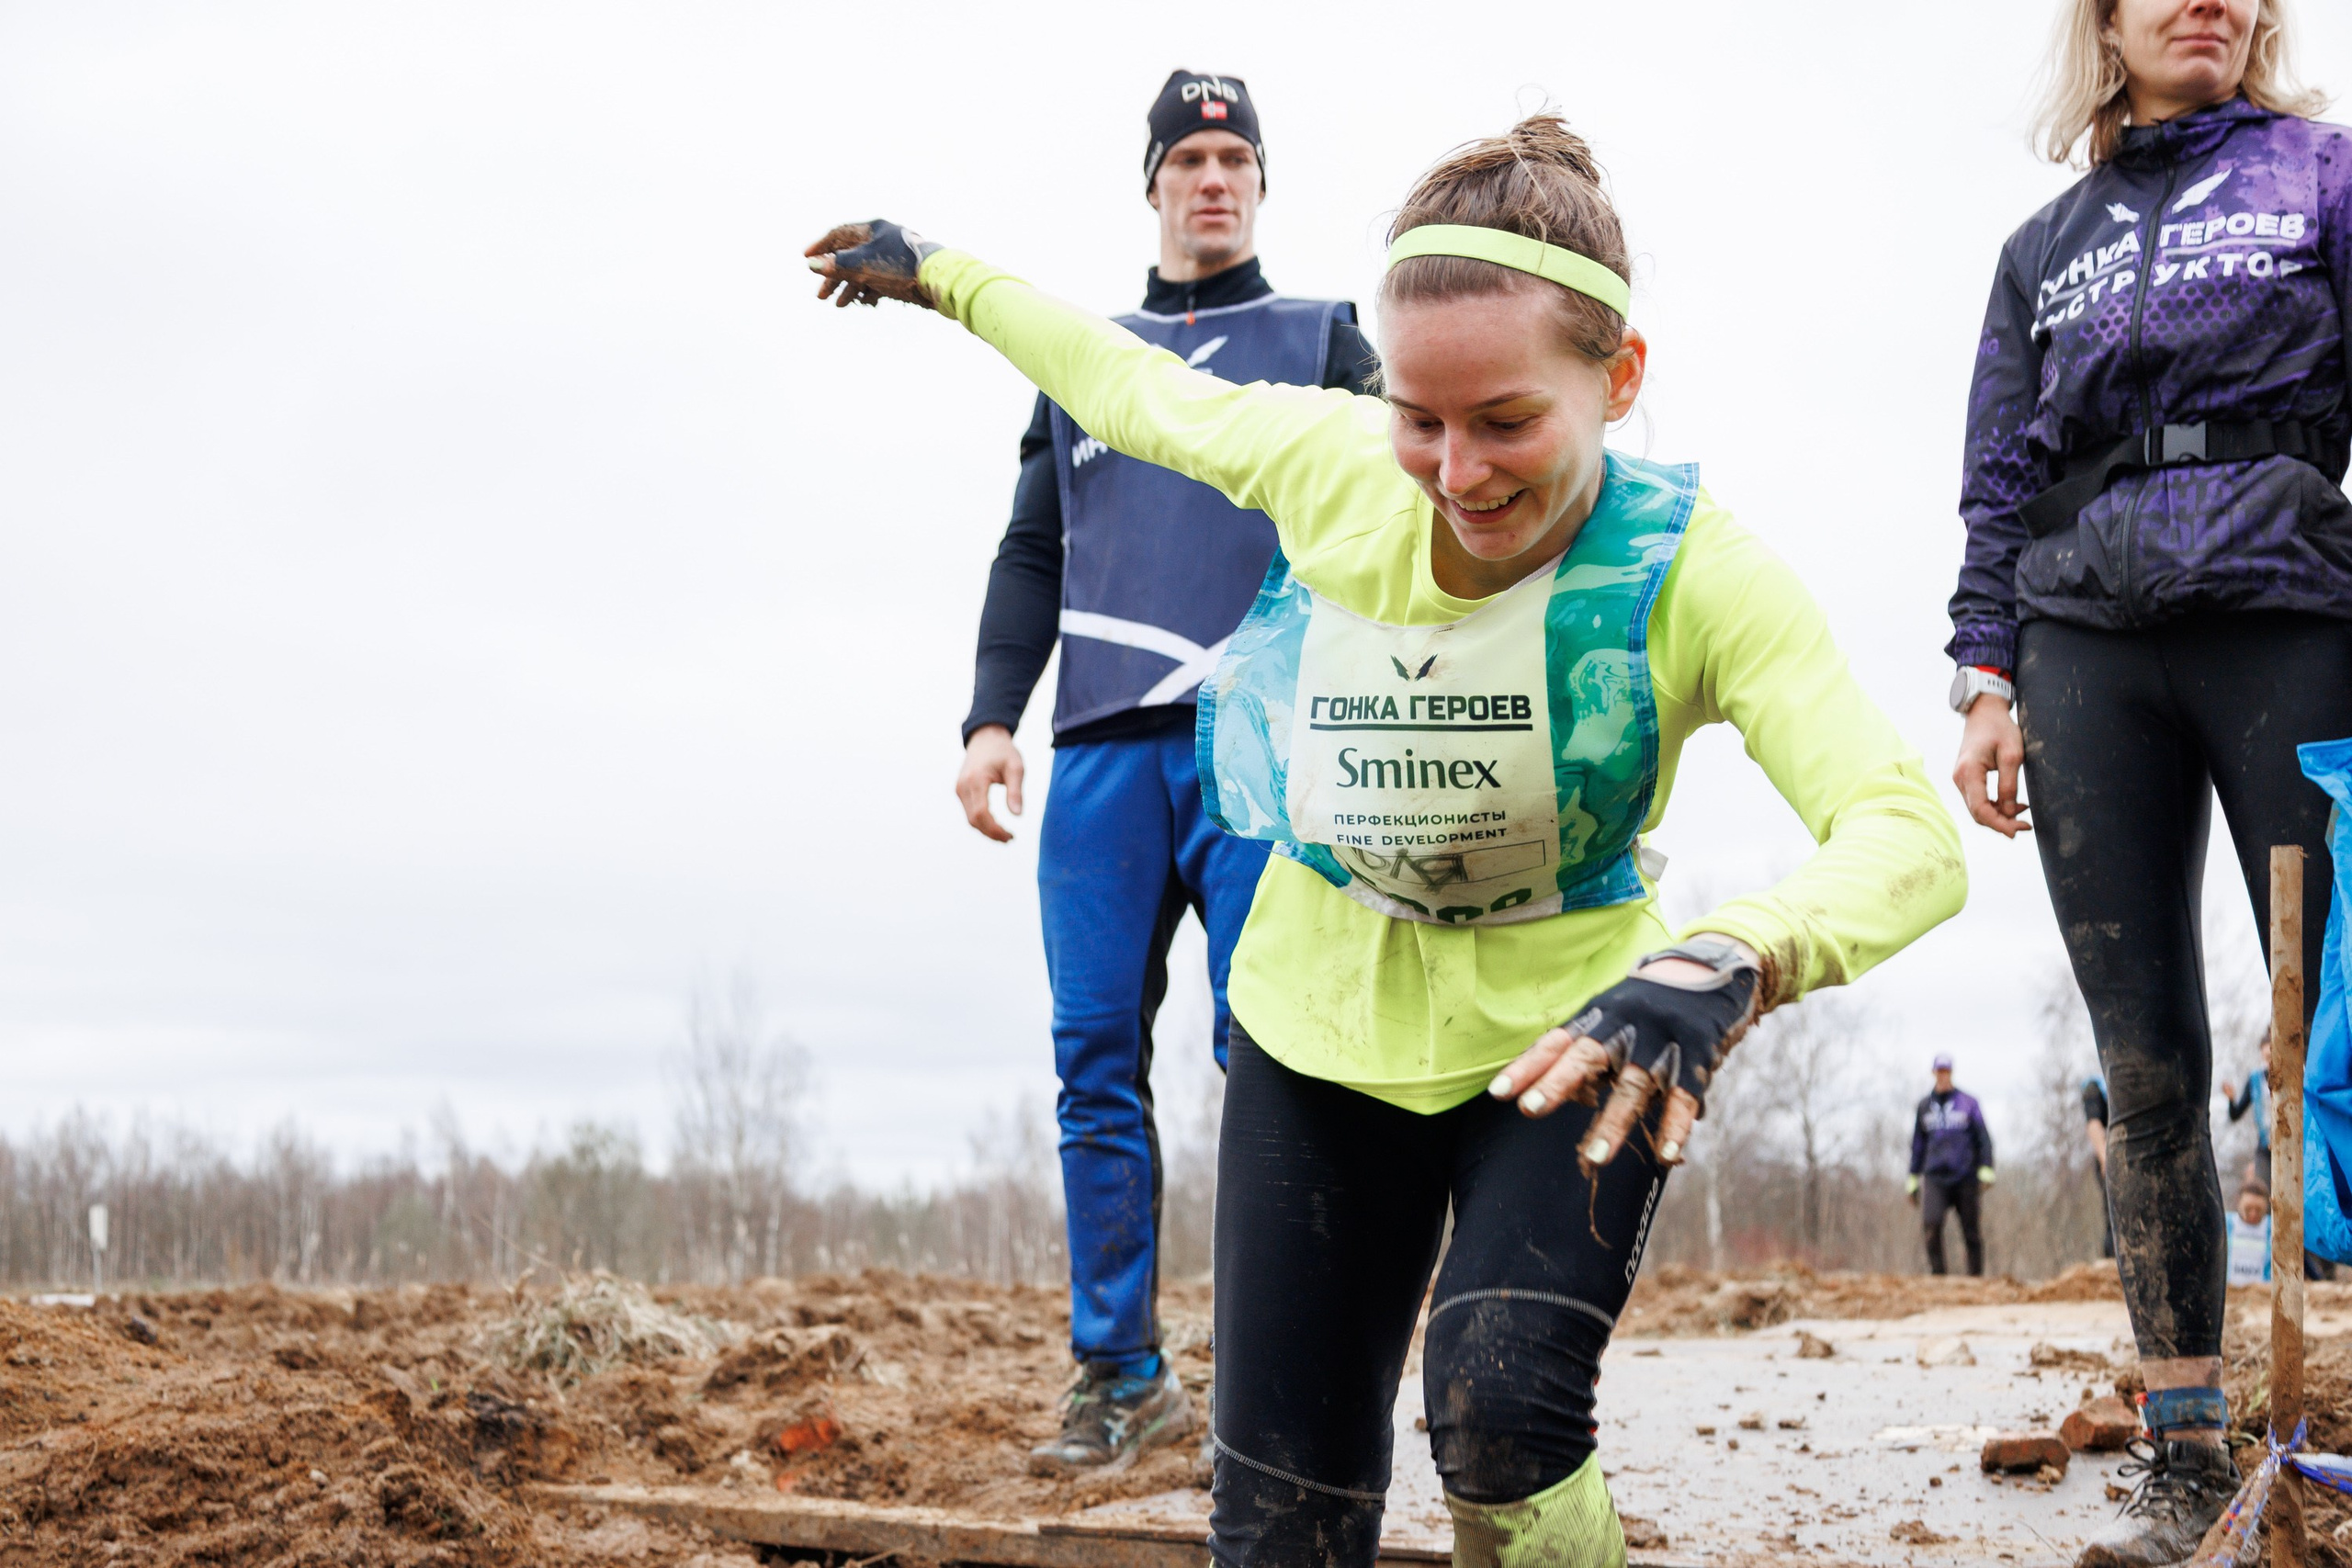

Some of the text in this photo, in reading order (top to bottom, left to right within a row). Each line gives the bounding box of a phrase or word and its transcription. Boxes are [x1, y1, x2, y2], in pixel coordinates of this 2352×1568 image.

[2159, 212, 2305, 248] ГЕРОЕВ
[1309, 694, 1532, 721] ГОНКА ГЕРОЕВ
[1336, 747, 1502, 790] Sminex
[1334, 810, 1507, 828] ПЕРФЕКЦИОНИСТЫ
[1337, 828, 1508, 846] FINE DEVELOPMENT
